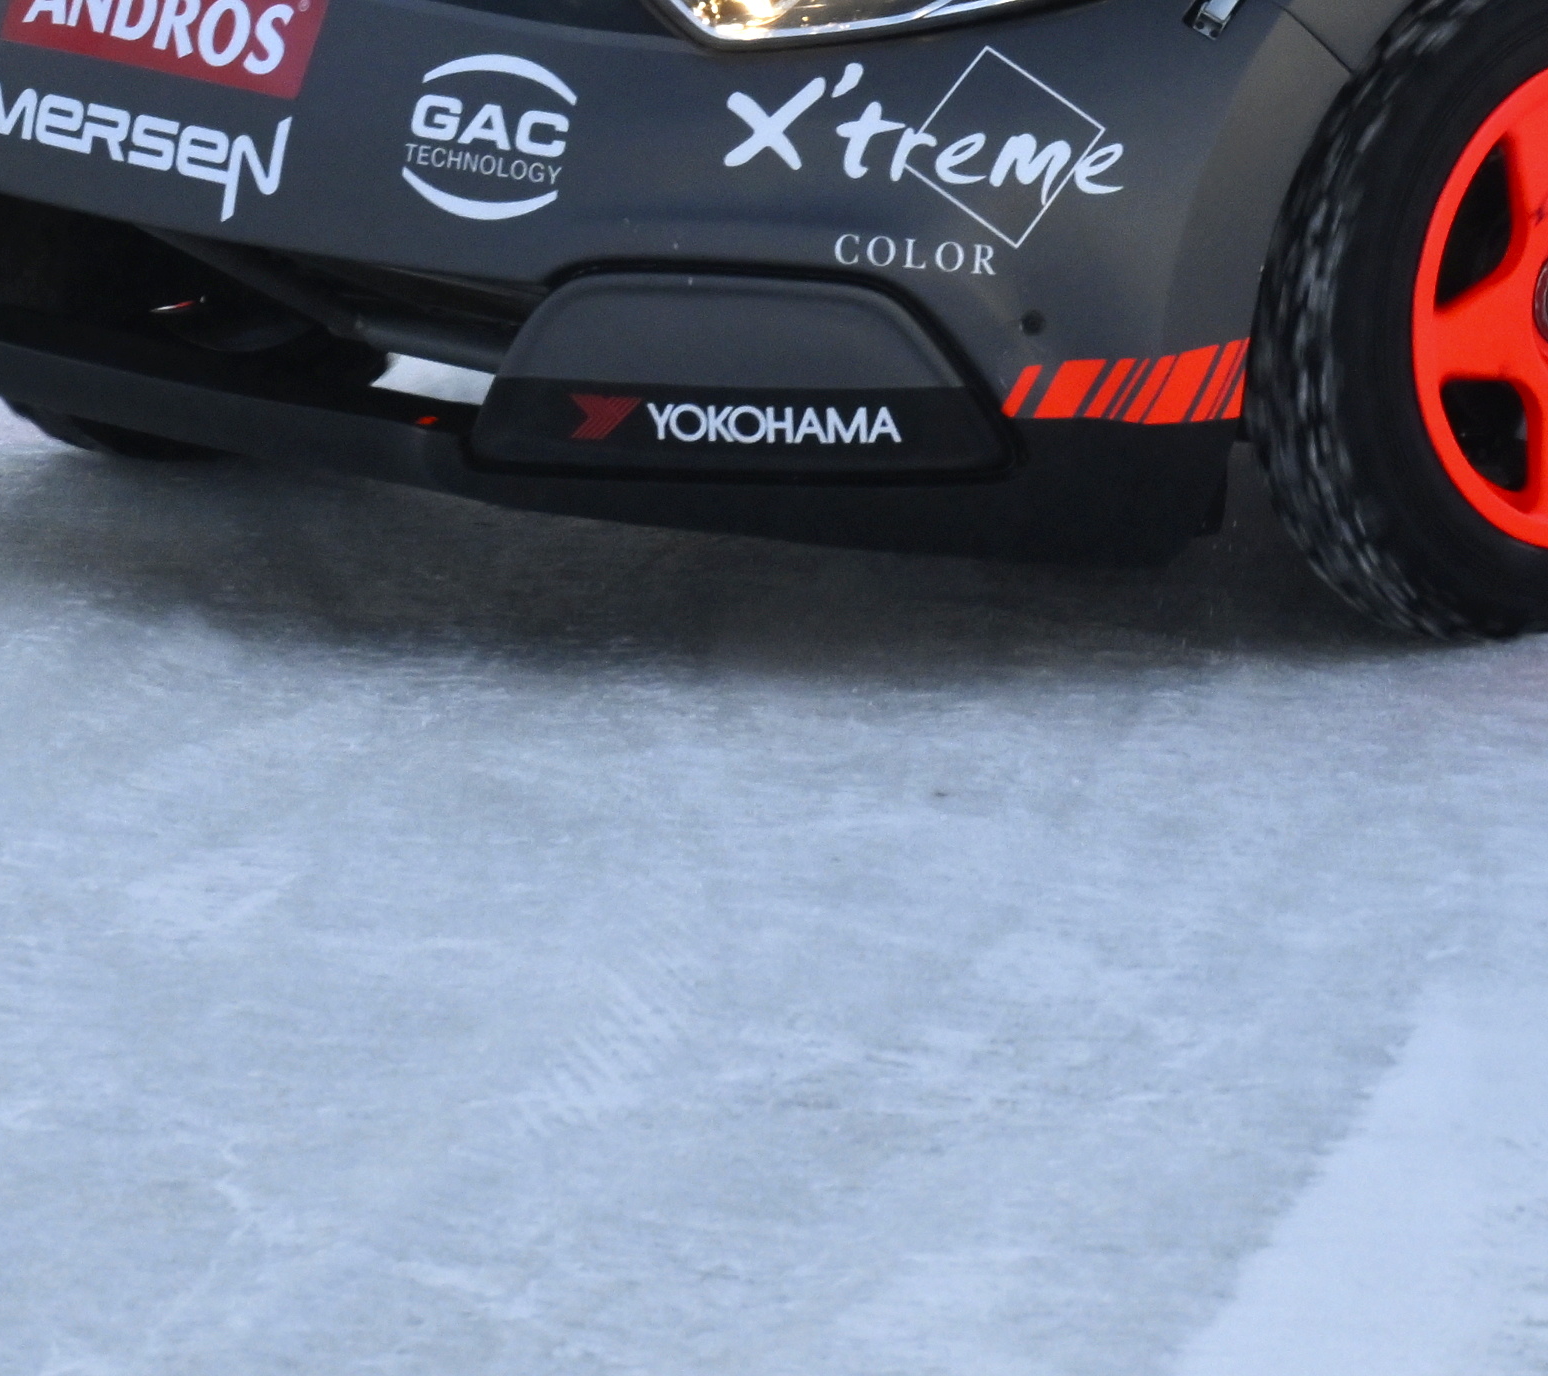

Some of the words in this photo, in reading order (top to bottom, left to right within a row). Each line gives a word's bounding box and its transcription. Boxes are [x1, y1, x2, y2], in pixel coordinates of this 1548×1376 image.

[409, 93, 571, 158] GAC
[404, 142, 563, 186] TECHNOLOGY
[832, 232, 998, 277] COLOR
[645, 400, 903, 447] YOKOHAMA
